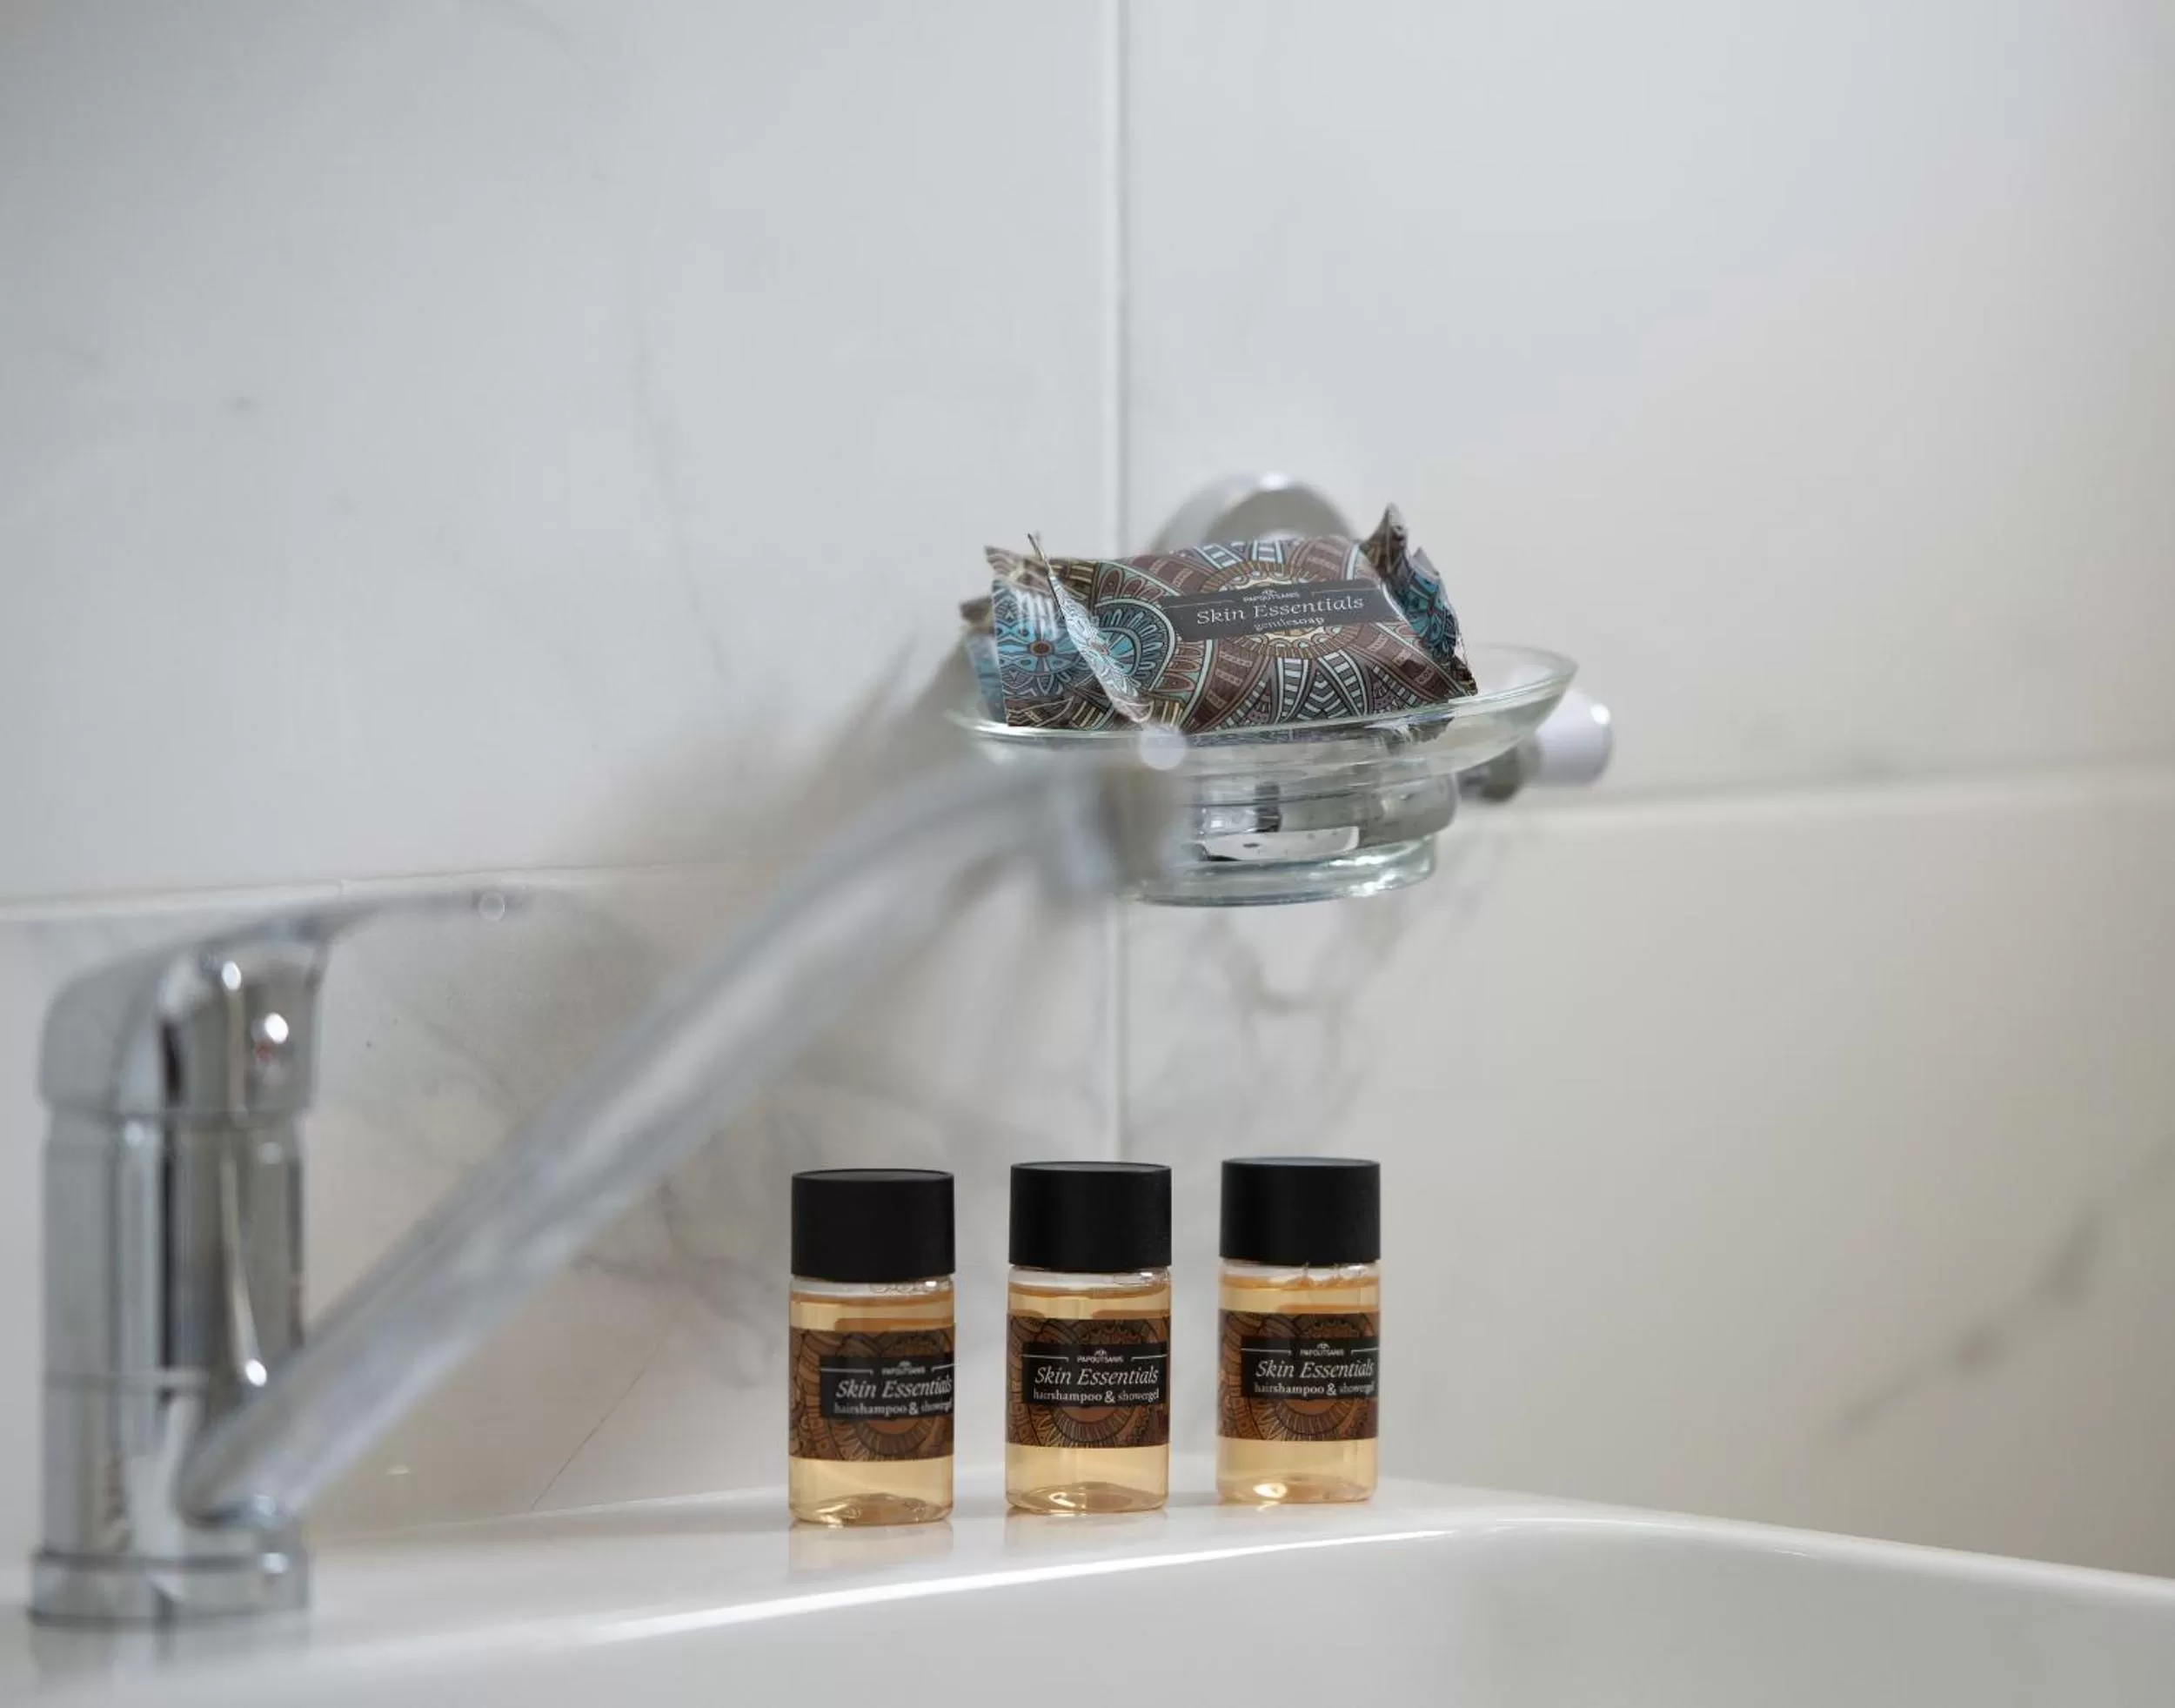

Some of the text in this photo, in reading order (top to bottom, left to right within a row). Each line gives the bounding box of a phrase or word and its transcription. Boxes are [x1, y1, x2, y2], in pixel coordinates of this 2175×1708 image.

[1196, 595, 1364, 625] Skin Essentials
[1254, 617, 1325, 632] gentlesoap
[1034, 1364, 1159, 1386] Skin Essentials
[1255, 1357, 1375, 1379] Skin Essentials
[835, 1373, 953, 1398] Skin Essentials
[1254, 1382, 1325, 1397] hairshampoo
[1326, 1383, 1337, 1396] &
[1033, 1388, 1160, 1404] hairshampoo & showergel
[833, 1402, 907, 1417] hairshampoo
[908, 1402, 919, 1416] &
